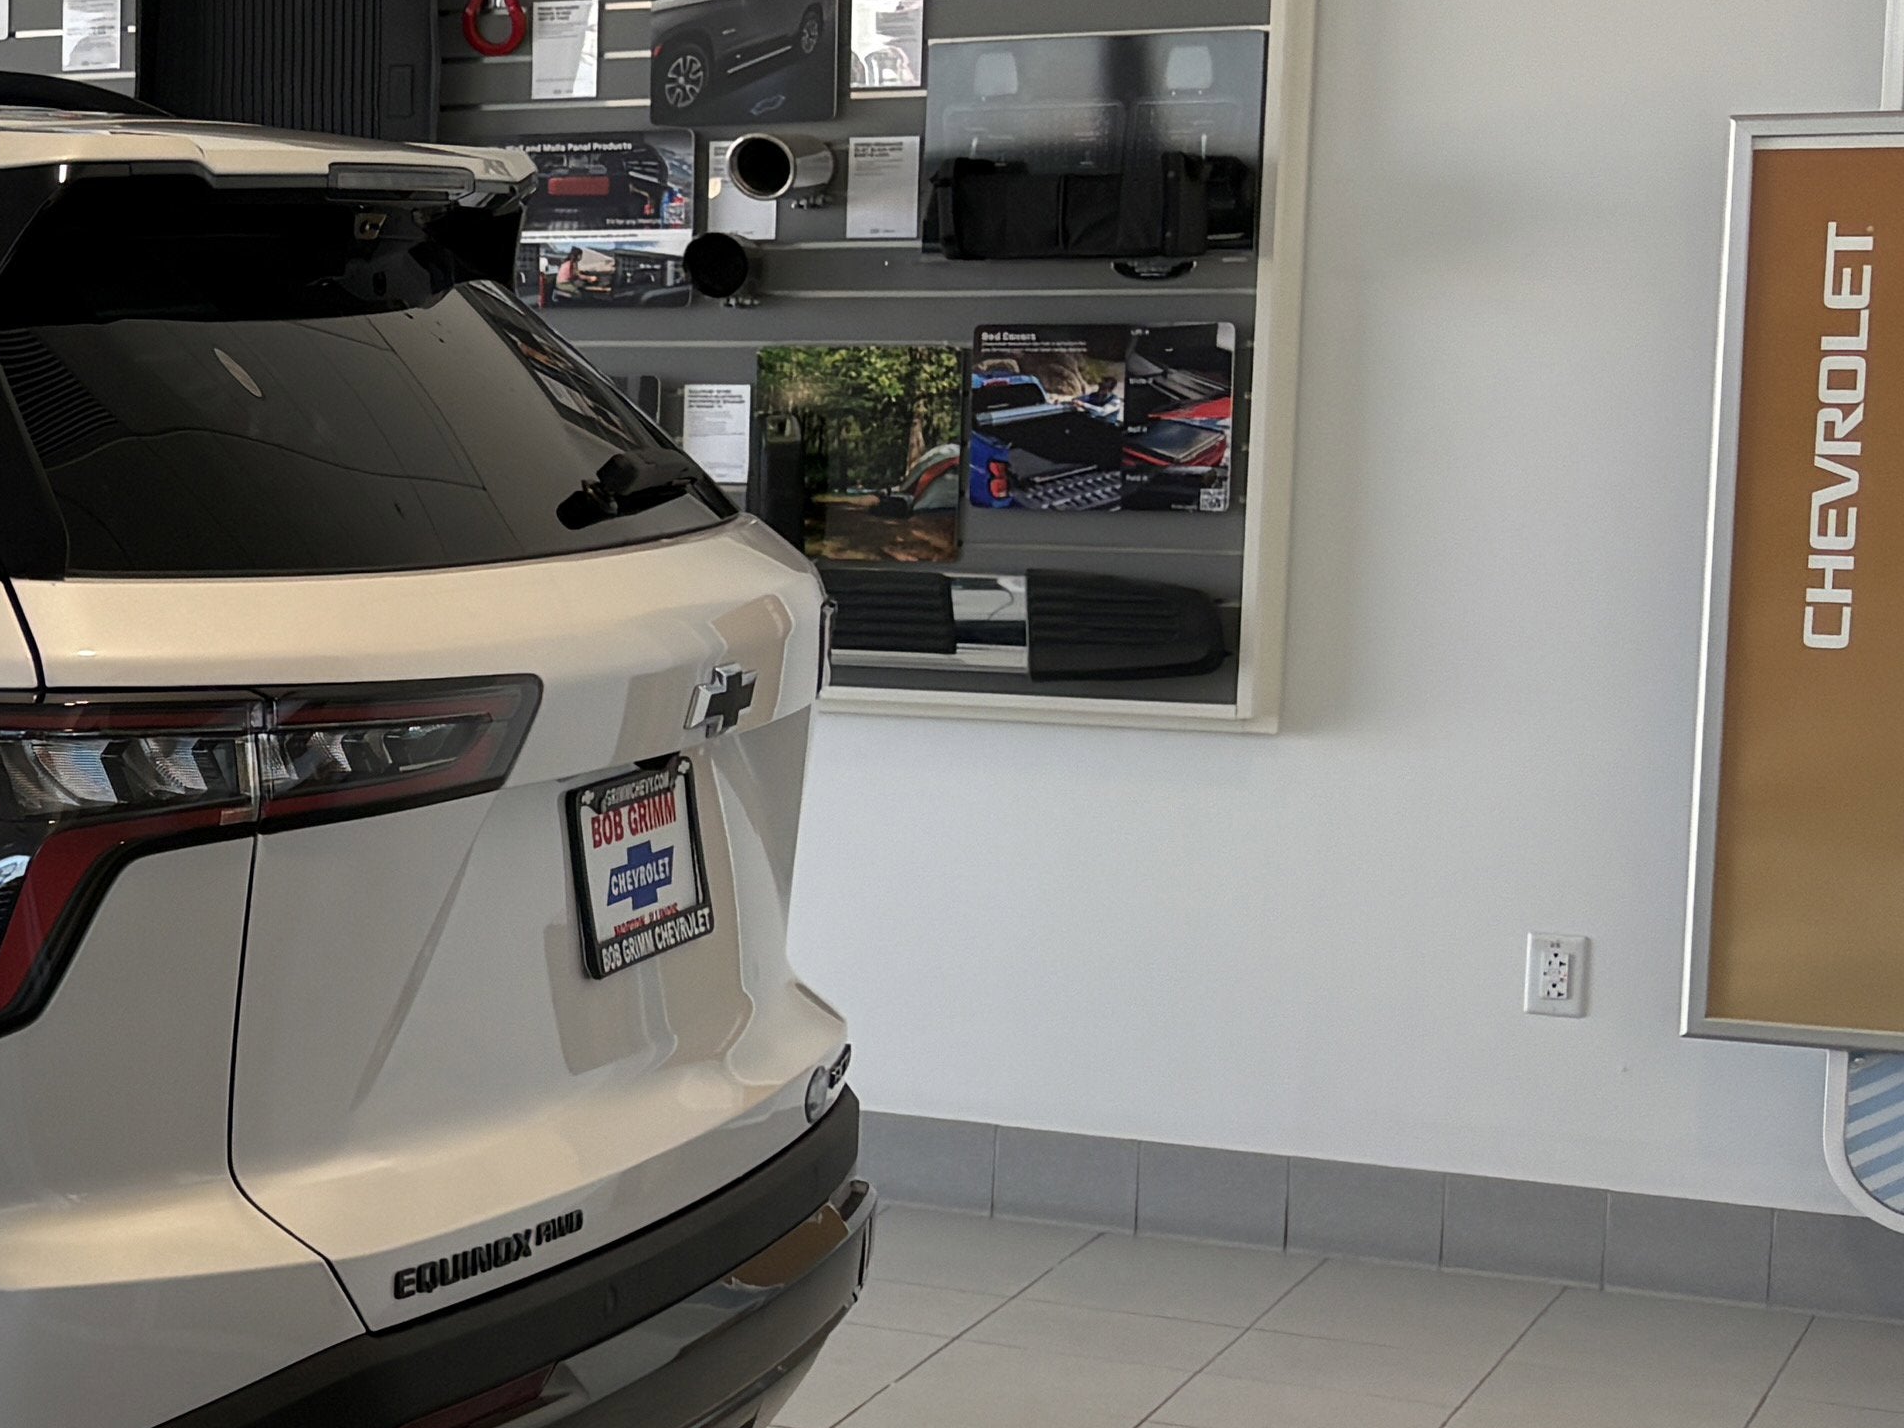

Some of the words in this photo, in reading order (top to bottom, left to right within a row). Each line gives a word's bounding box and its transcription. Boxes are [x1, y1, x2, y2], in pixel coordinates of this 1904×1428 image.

[525, 144, 541, 152] and
[567, 142, 591, 151] Panel
[592, 141, 633, 151] Products
[1803, 221, 1874, 650] CHEVROLET
[591, 808, 623, 849] BOB
[627, 792, 677, 837] GRIMM
[611, 858, 670, 896] CHEVROLET
[601, 941, 623, 973] BOB
[622, 928, 655, 964] GRIMM
[654, 907, 711, 950] CHEVROLET
[393, 1229, 533, 1300] EQUINOX
[535, 1209, 584, 1246] AWD
